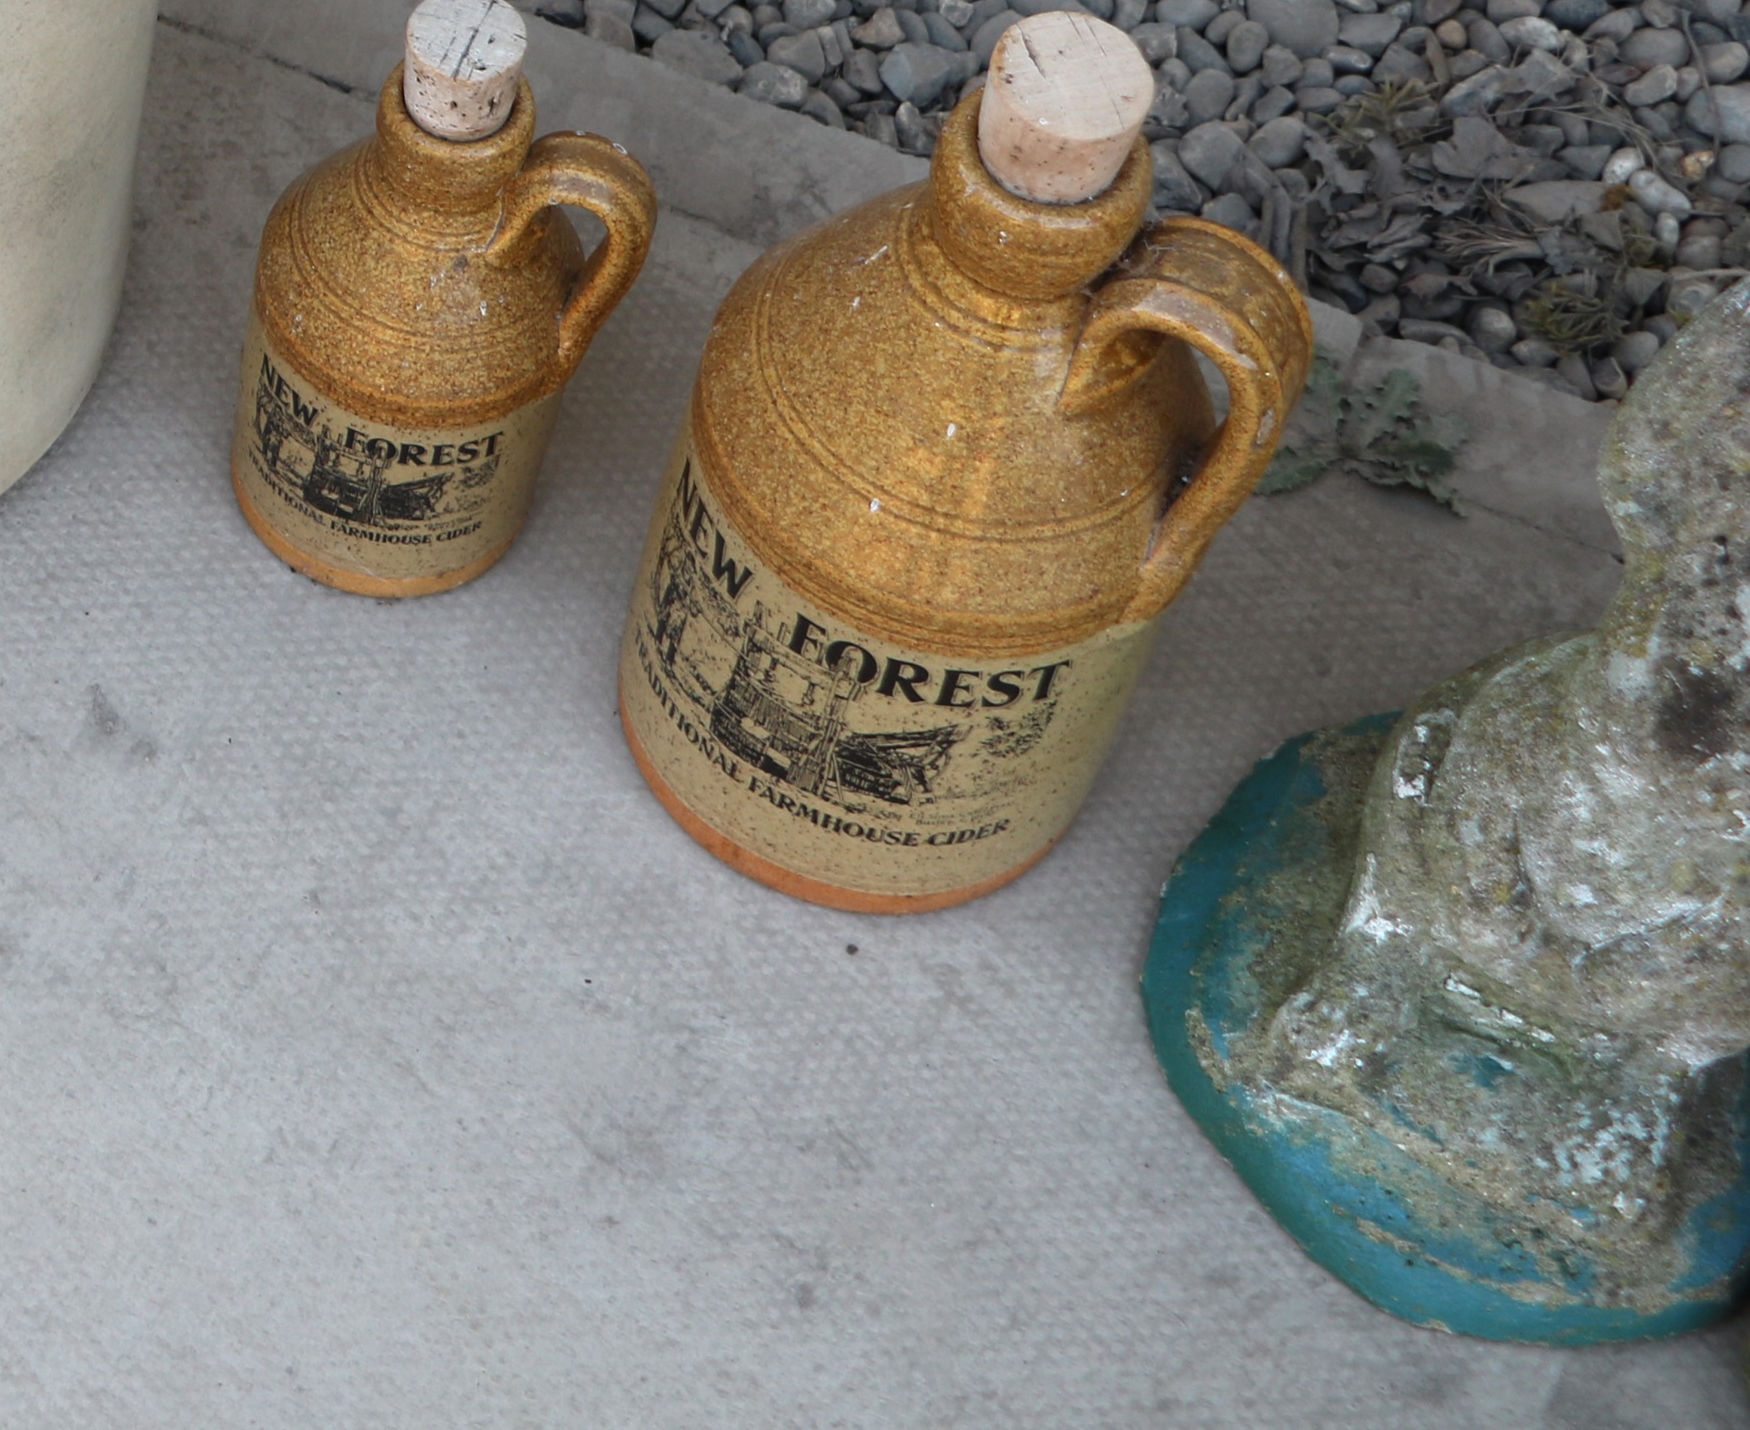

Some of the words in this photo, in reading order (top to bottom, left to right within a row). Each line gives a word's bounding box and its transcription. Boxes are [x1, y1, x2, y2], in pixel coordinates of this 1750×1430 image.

[260, 352, 319, 426] NEW
[345, 426, 504, 467] FOREST
[330, 520, 432, 545] FARMHOUSE
[435, 520, 483, 542] CIDER
[677, 456, 754, 600] NEW
[788, 611, 1072, 709] FOREST
[747, 775, 922, 847] FARMHOUSE
[925, 818, 1011, 847] CIDER
